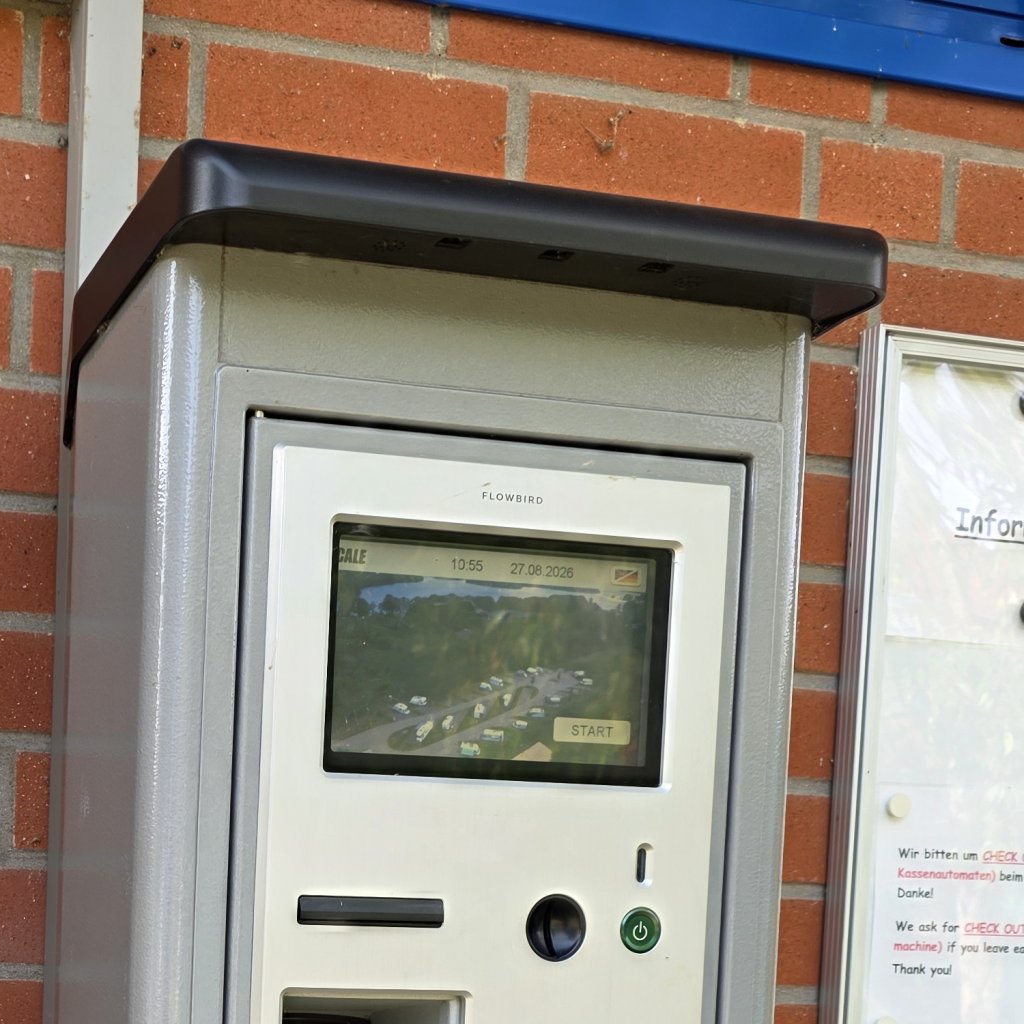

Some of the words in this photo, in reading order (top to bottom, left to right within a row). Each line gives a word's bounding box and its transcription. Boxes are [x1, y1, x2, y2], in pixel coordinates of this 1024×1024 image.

[482, 491, 544, 505] FLOWBIRD
[451, 558, 483, 572] 10:55
[510, 562, 574, 579] 27.08.2026
[571, 725, 614, 738] START
[898, 848, 919, 858] Wir
[924, 848, 958, 860] bitten
[963, 852, 978, 861] um
[983, 850, 1018, 862] CHECK
[897, 867, 996, 882] Kassenautomaten)
[999, 871, 1023, 882] beim
[898, 887, 934, 898] Danke!
[896, 921, 914, 931] We
[919, 922, 937, 931] ask
[942, 922, 959, 933] for
[964, 923, 999, 933] CHECK
[893, 941, 942, 953] machine)
[947, 941, 956, 953] if
[961, 944, 979, 955] you
[983, 942, 1009, 953] leave
[892, 963, 925, 974] Thank
[930, 964, 952, 978] you!
